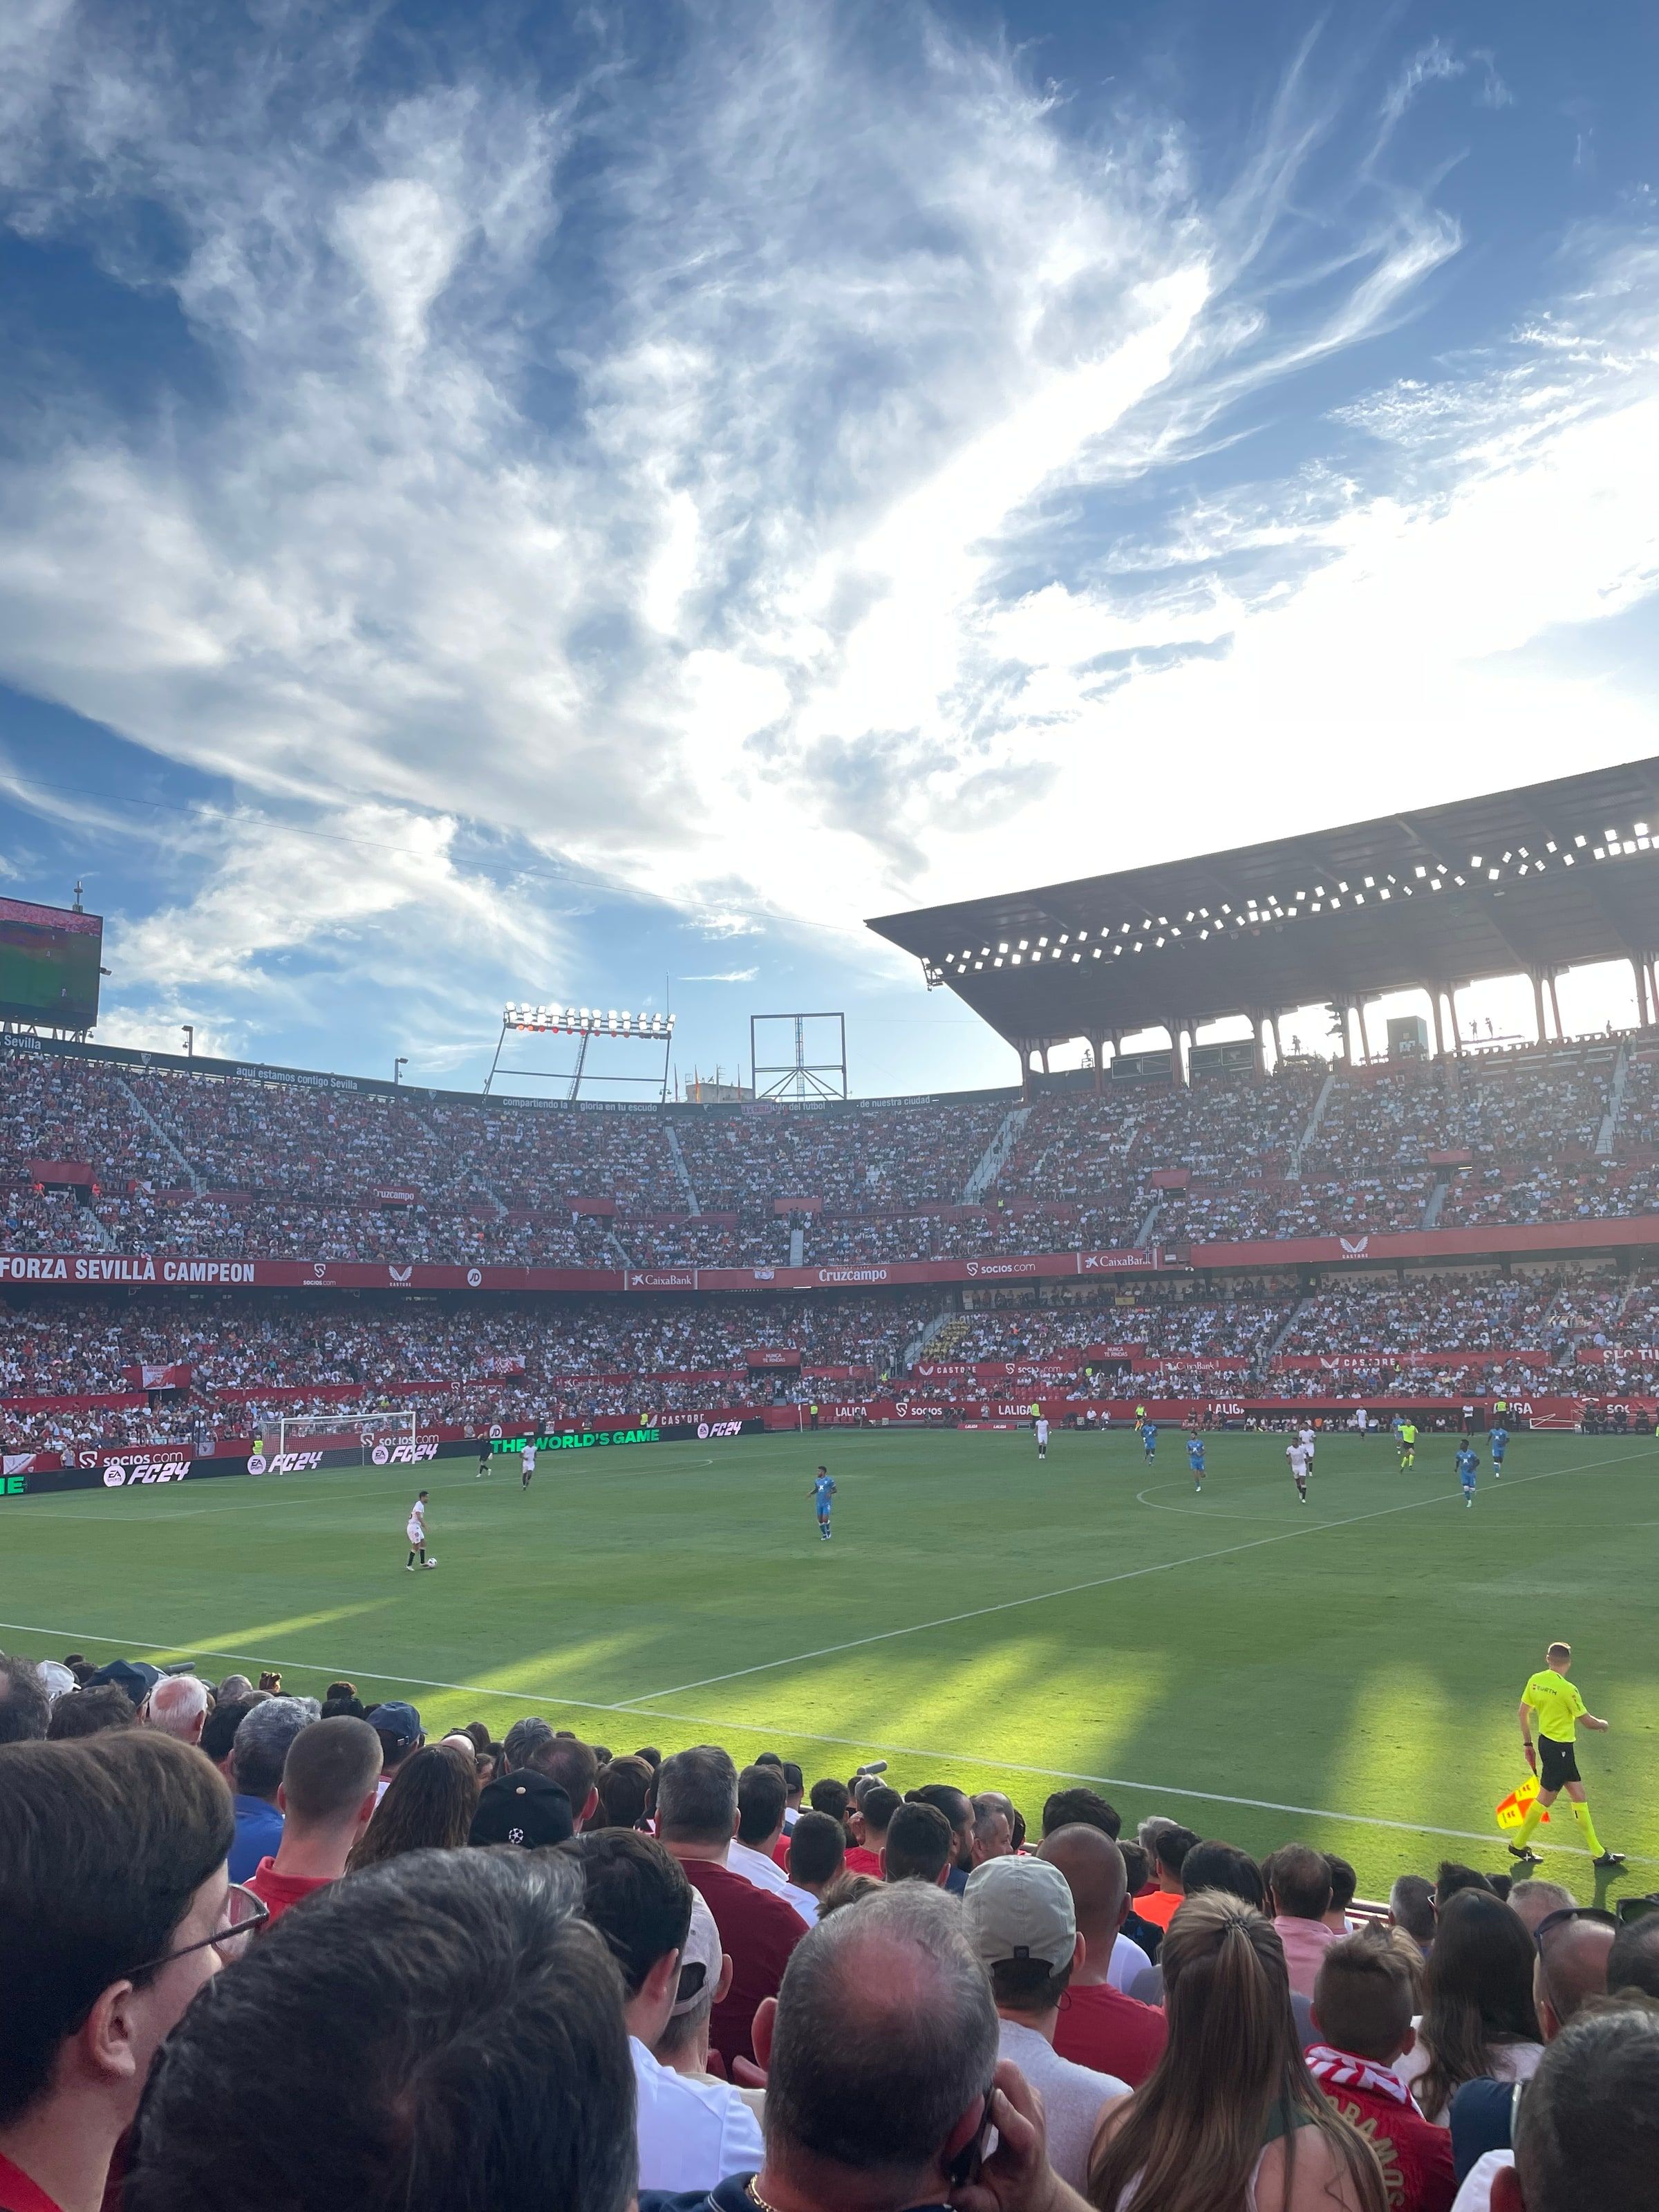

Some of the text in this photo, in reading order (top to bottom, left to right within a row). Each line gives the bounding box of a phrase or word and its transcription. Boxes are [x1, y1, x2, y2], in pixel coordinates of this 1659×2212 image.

[4, 1035, 41, 1050] Sevilla
[236, 1067, 358, 1090] aquí estamos contigo Sevilla
[503, 1098, 559, 1109] compartiendo
[560, 1100, 568, 1109] la
[580, 1101, 603, 1112] gloria
[617, 1103, 626, 1111] tu
[628, 1102, 657, 1112] escudo
[789, 1103, 801, 1111] del
[860, 1095, 930, 1108] de nuestra ciudad
[0, 1257, 68, 1279] FORZA
[163, 1262, 254, 1282] CAMPEON
[818, 1268, 888, 1282] Cruzcampo
[645, 1275, 692, 1286] CaixaBank
[709, 1421, 742, 1437] FC24
[489, 1429, 660, 1454] THE WORLD'S GAME
[268, 1451, 324, 1473] FC24
[108, 1470, 121, 1479] EA
[127, 1461, 191, 1485] FC24
